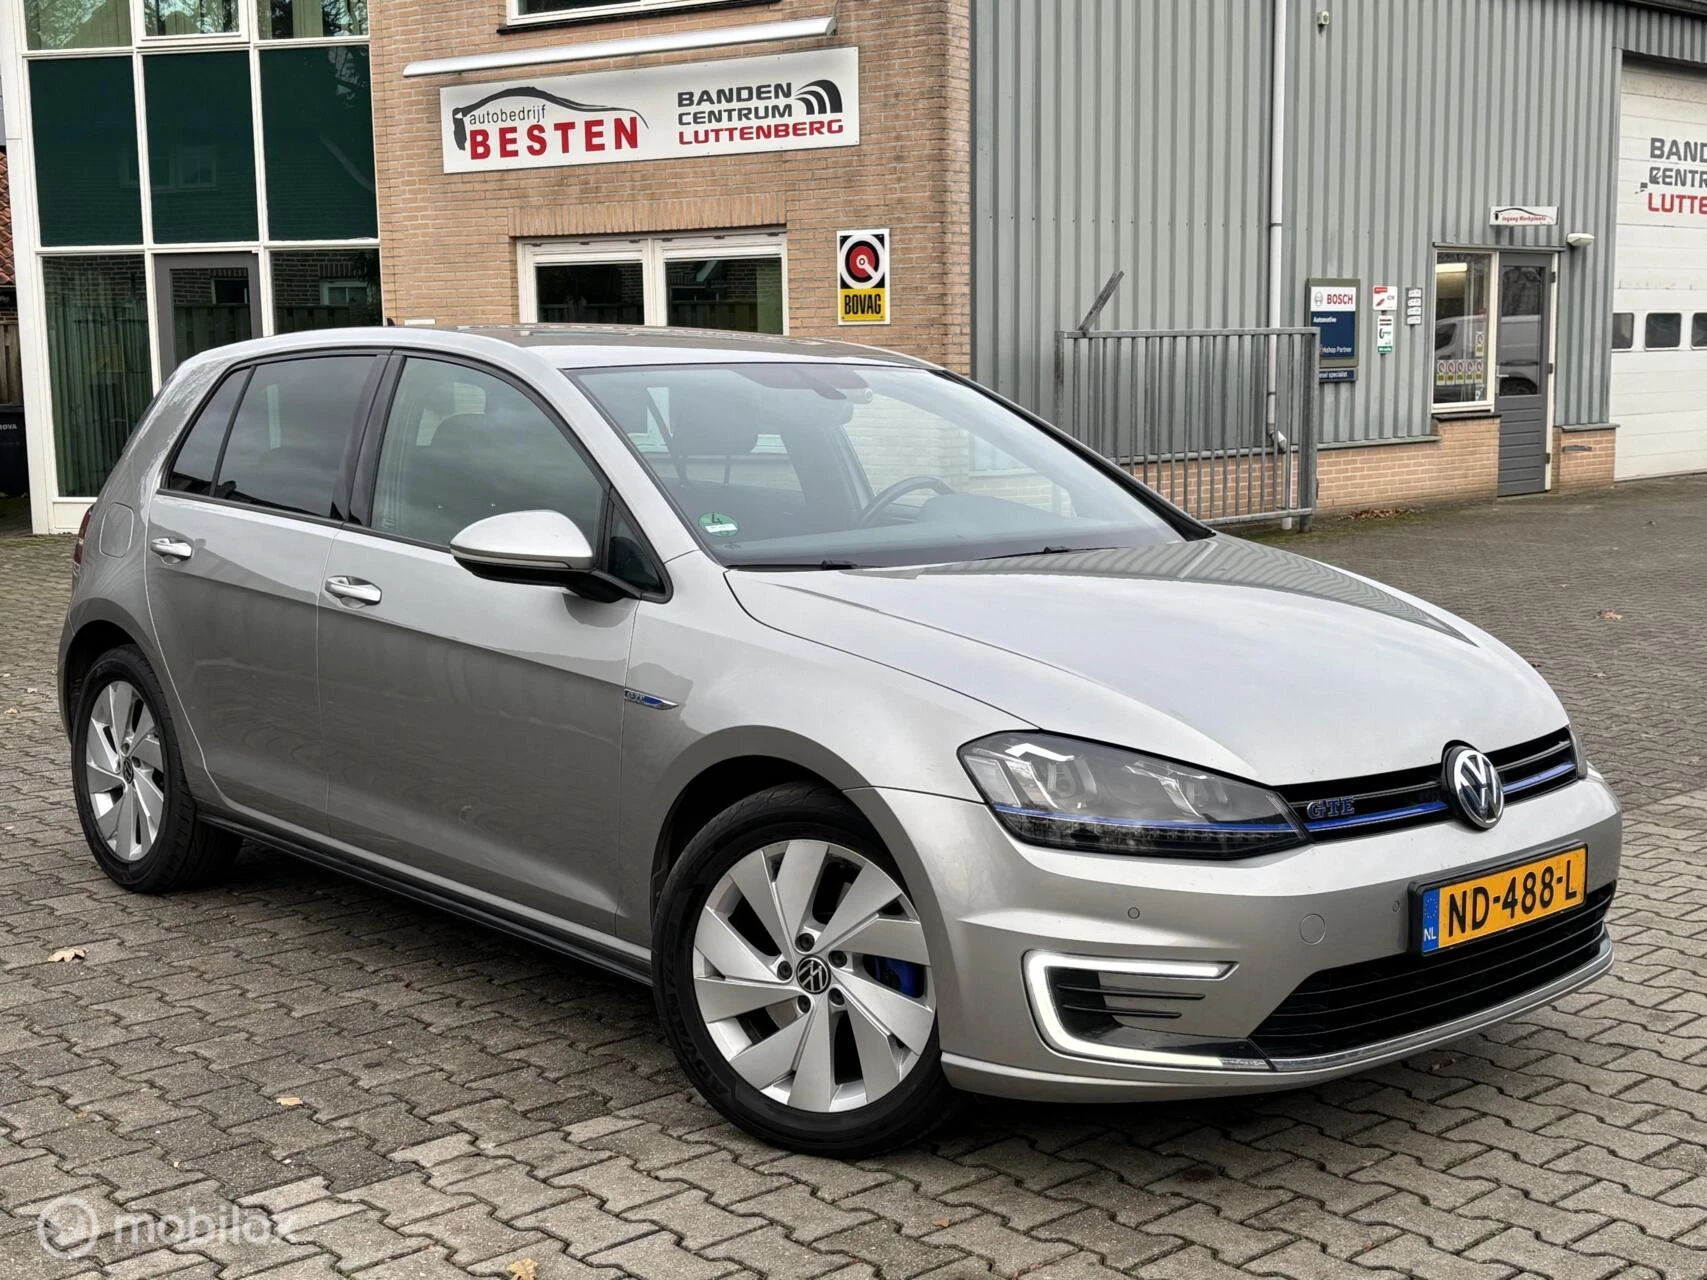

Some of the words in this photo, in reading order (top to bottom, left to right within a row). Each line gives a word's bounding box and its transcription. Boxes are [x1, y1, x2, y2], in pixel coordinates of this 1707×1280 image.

[677, 82, 792, 108] BANDEN
[469, 104, 546, 125] autobedrijf
[678, 103, 792, 126] CENTRUM
[469, 116, 638, 160] BESTEN
[678, 119, 844, 145] LUTTENBERG
[844, 293, 881, 315] BOVAG
[1326, 293, 1353, 305] BOSCH
[1306, 796, 1356, 820] GTE
[1448, 859, 1577, 938] ND-488-L
[1423, 927, 1437, 942] NL
